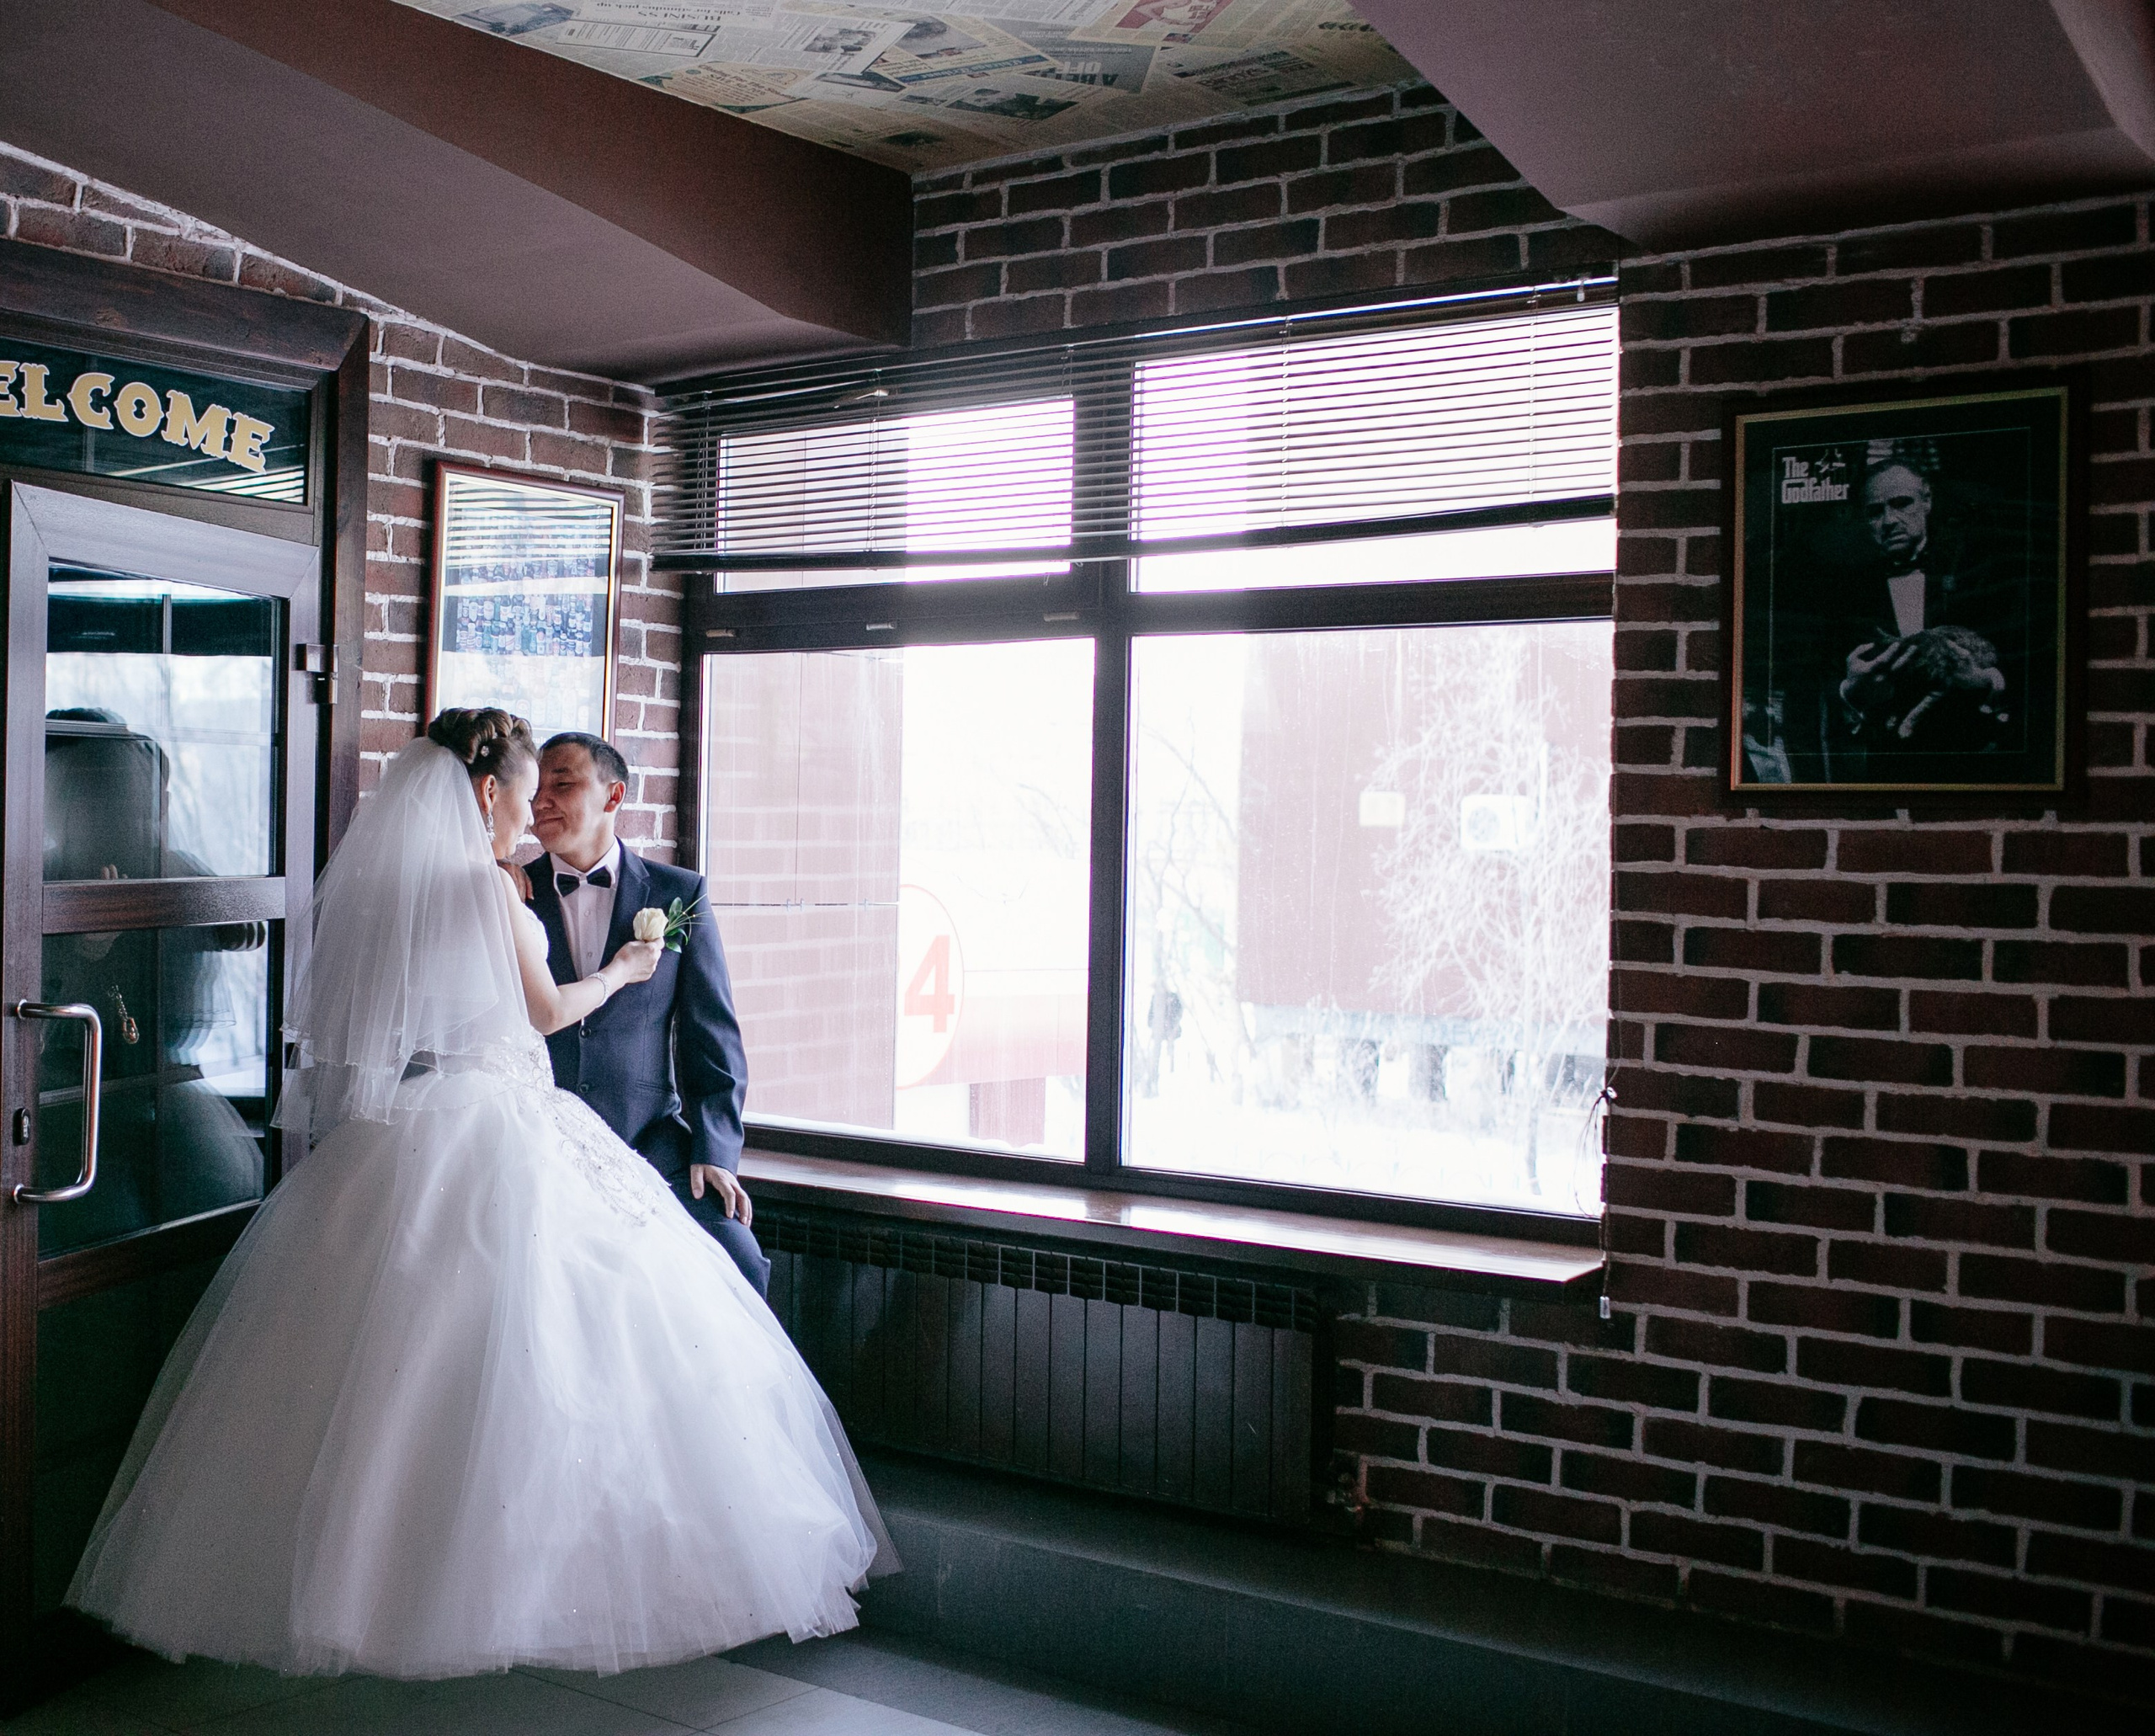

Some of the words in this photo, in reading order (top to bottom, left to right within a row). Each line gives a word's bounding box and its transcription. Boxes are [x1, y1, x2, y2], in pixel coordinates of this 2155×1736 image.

[1781, 456, 1810, 479] The
[1781, 476, 1850, 504] Godfather
[903, 935, 955, 1033] 4
